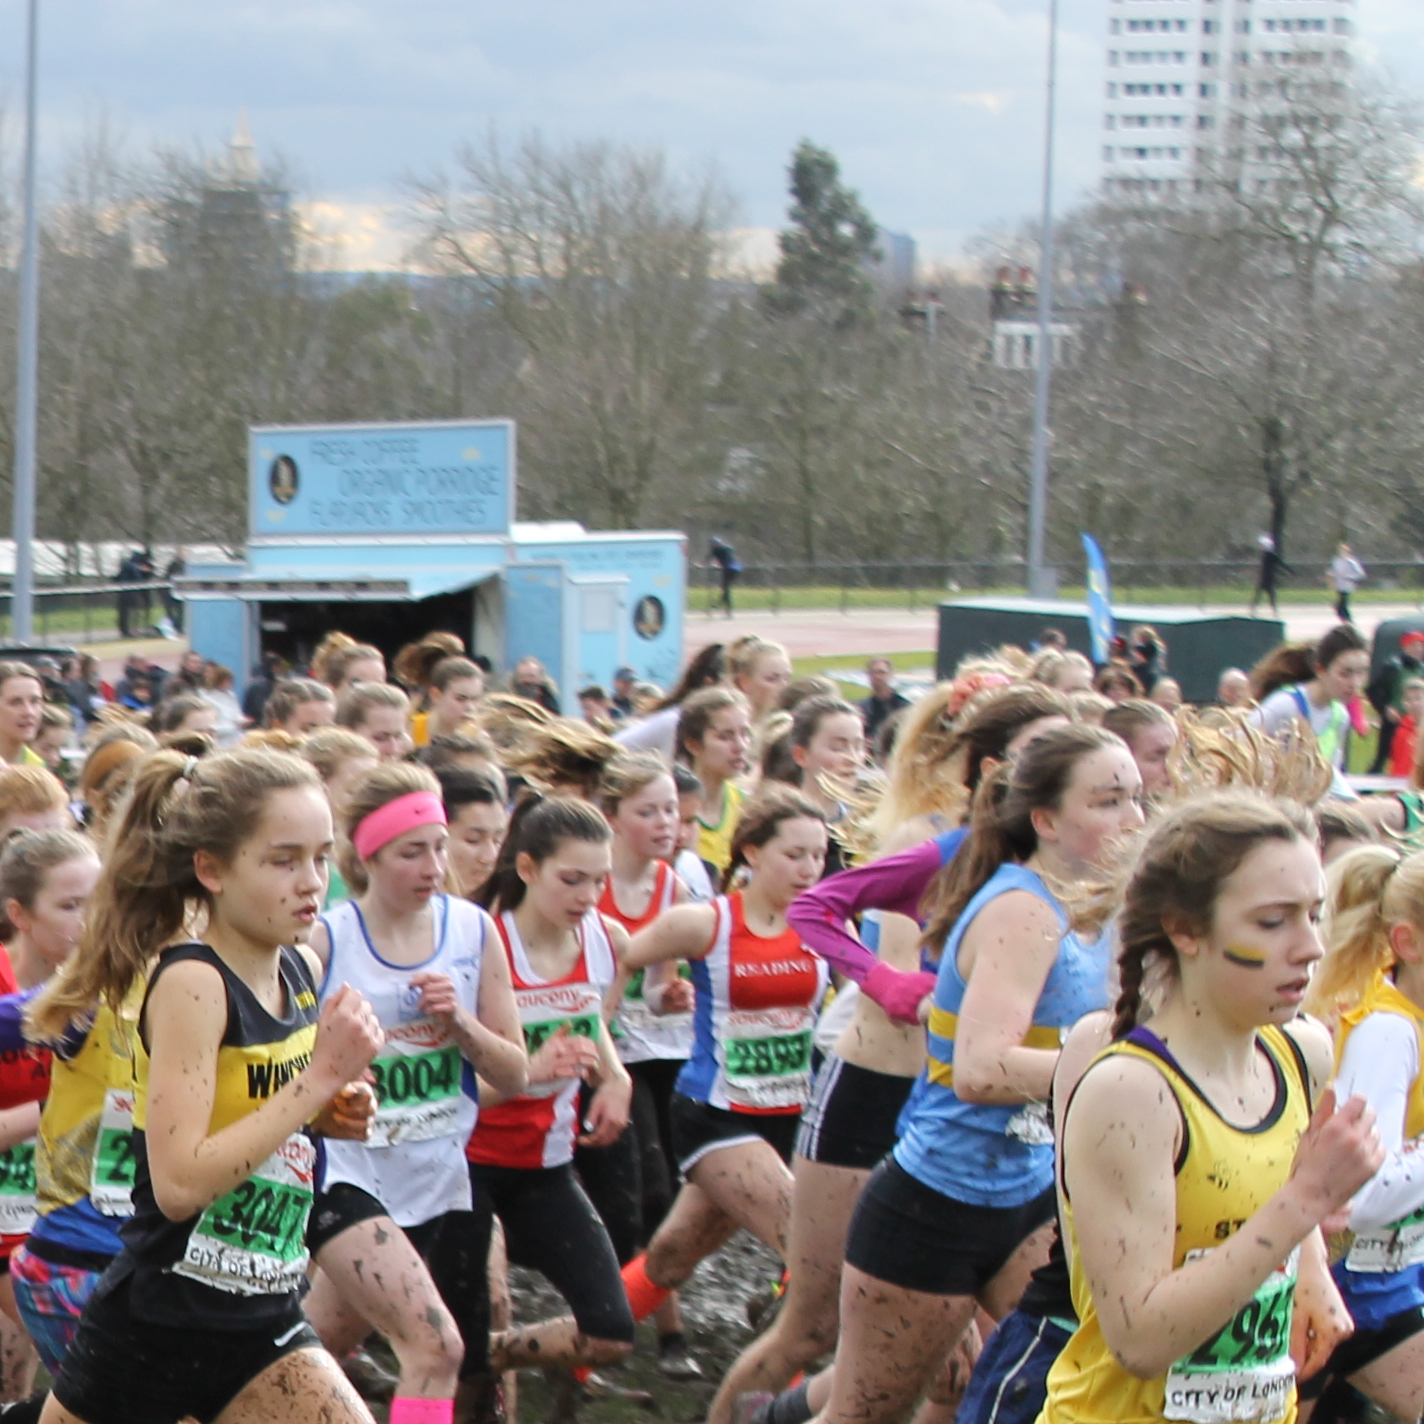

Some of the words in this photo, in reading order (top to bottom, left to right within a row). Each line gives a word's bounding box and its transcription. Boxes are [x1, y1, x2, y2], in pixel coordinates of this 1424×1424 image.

[733, 960, 813, 977] READING
[516, 989, 578, 1008] aucony
[1171, 1390, 1218, 1408] CITY
[1224, 1386, 1246, 1402] OF
